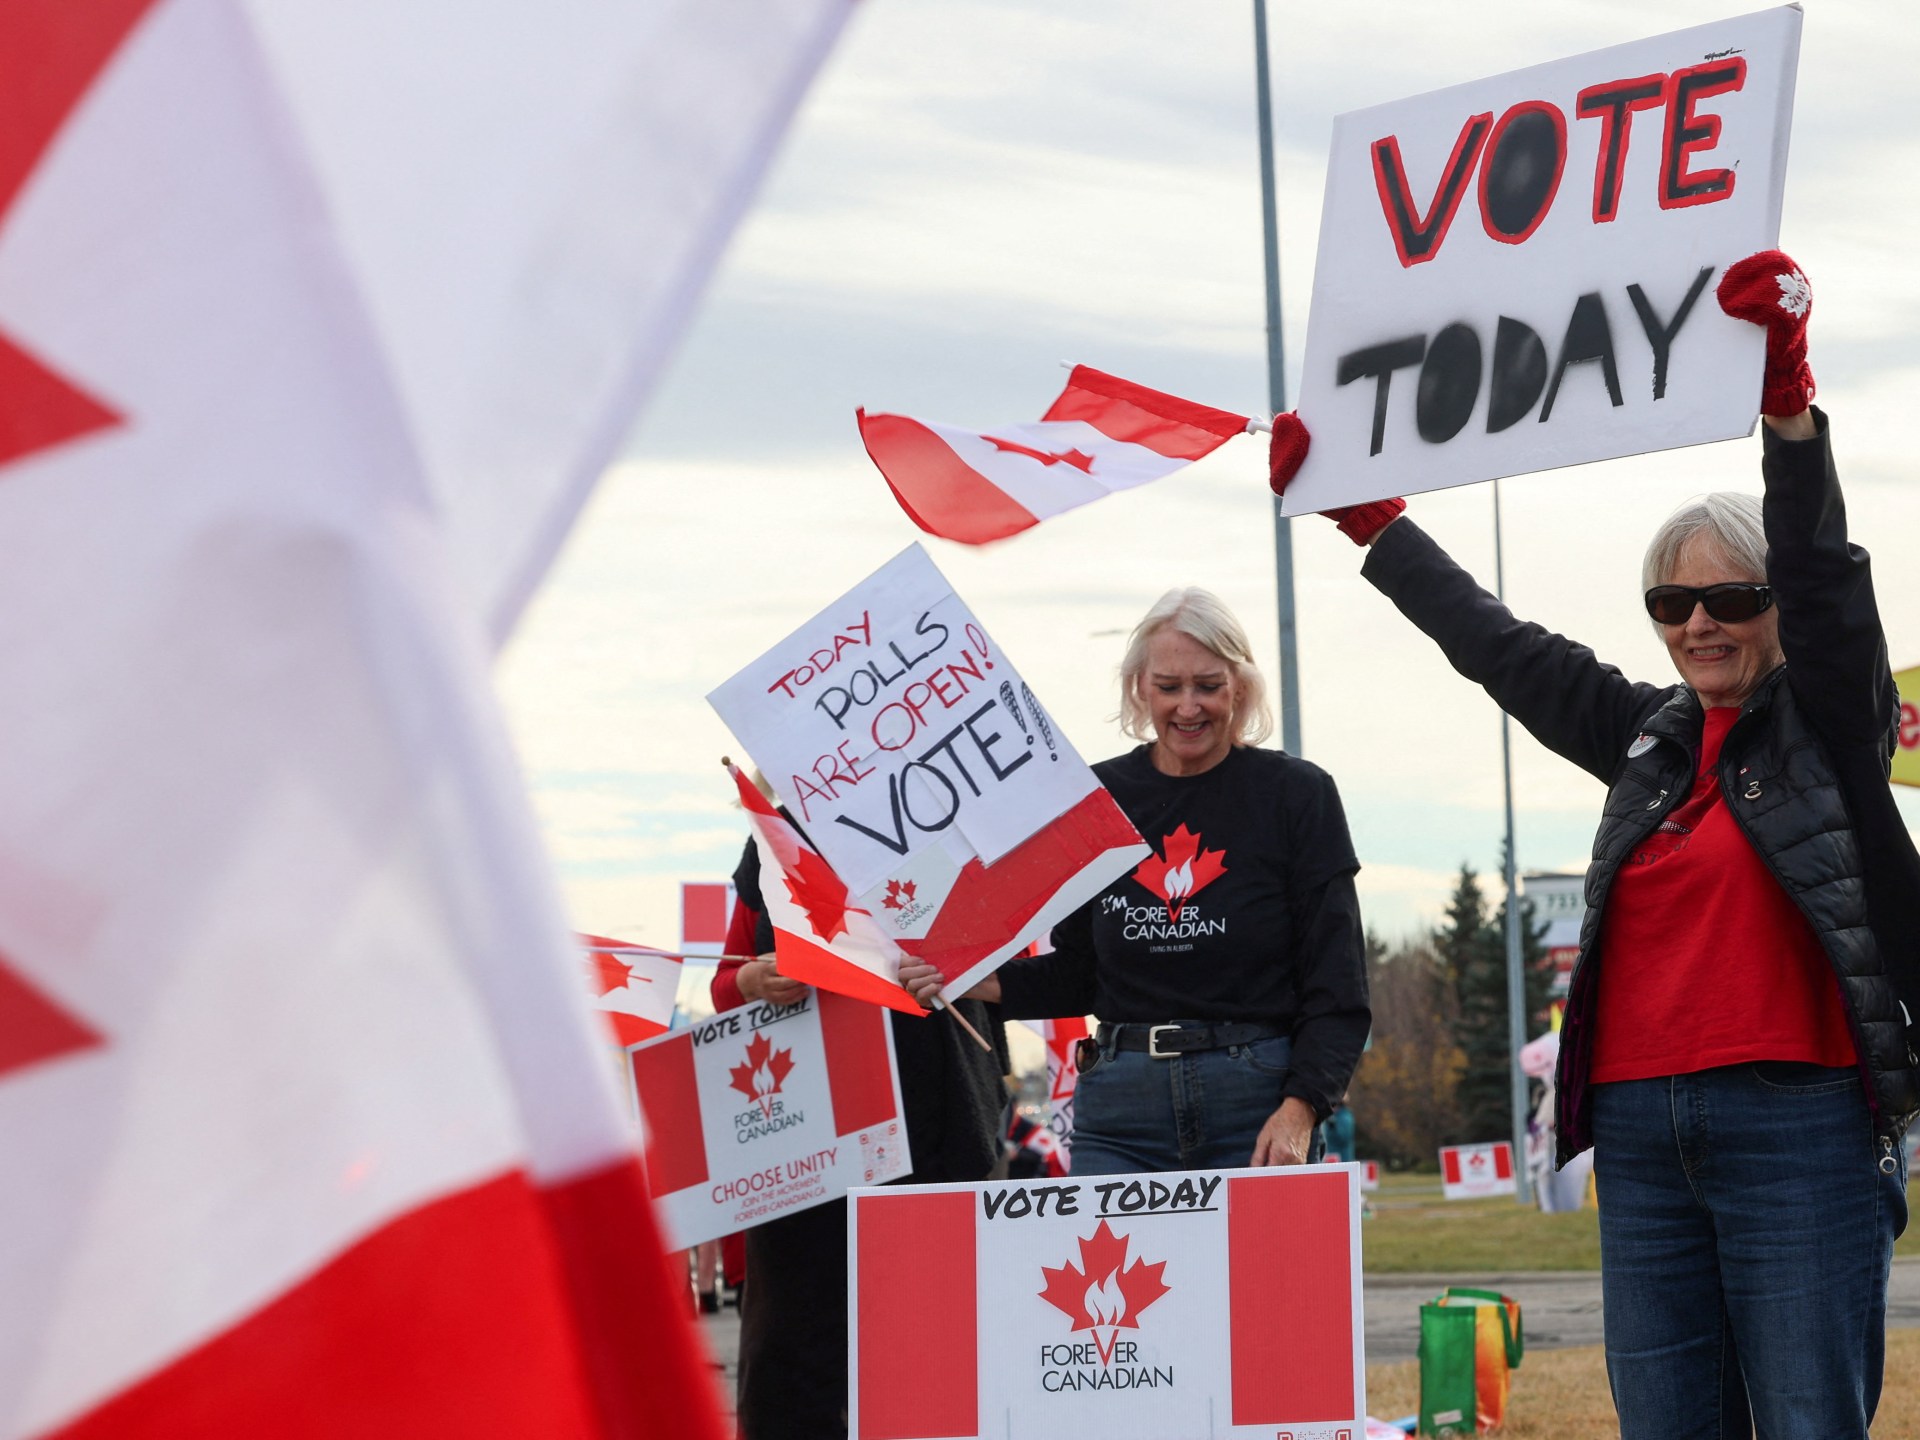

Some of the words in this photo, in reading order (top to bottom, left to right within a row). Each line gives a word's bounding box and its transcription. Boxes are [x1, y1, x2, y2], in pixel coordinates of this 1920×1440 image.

[1371, 57, 1747, 268] VOTE
[1335, 266, 1716, 457] TODAY
[767, 611, 872, 699] TODAY
[814, 612, 949, 730] POLLS
[791, 739, 876, 822] ARE
[871, 623, 994, 751] OPEN!
[894, 902, 920, 925] FOREVER
[899, 902, 934, 930] CANADIAN
[1101, 894, 1128, 914] I'M
[1124, 898, 1200, 924] FOREVER
[1123, 918, 1226, 940] CANADIAN
[1173, 943, 1194, 953] ALBERTA
[692, 1014, 741, 1047] VOTE
[734, 1096, 785, 1129] FOREVER
[737, 1110, 805, 1144] CANADIAN
[712, 1166, 782, 1204] CHOOSE
[787, 1147, 838, 1180] UNITY
[741, 1196, 761, 1209] JOIN
[761, 1189, 775, 1200] THE
[775, 1175, 821, 1195] MOVEMENT
[983, 1184, 1080, 1220] VOTE
[1094, 1176, 1221, 1215] TODAY
[1041, 1329, 1138, 1367] FOREVER
[1042, 1366, 1173, 1393] CANADIAN
